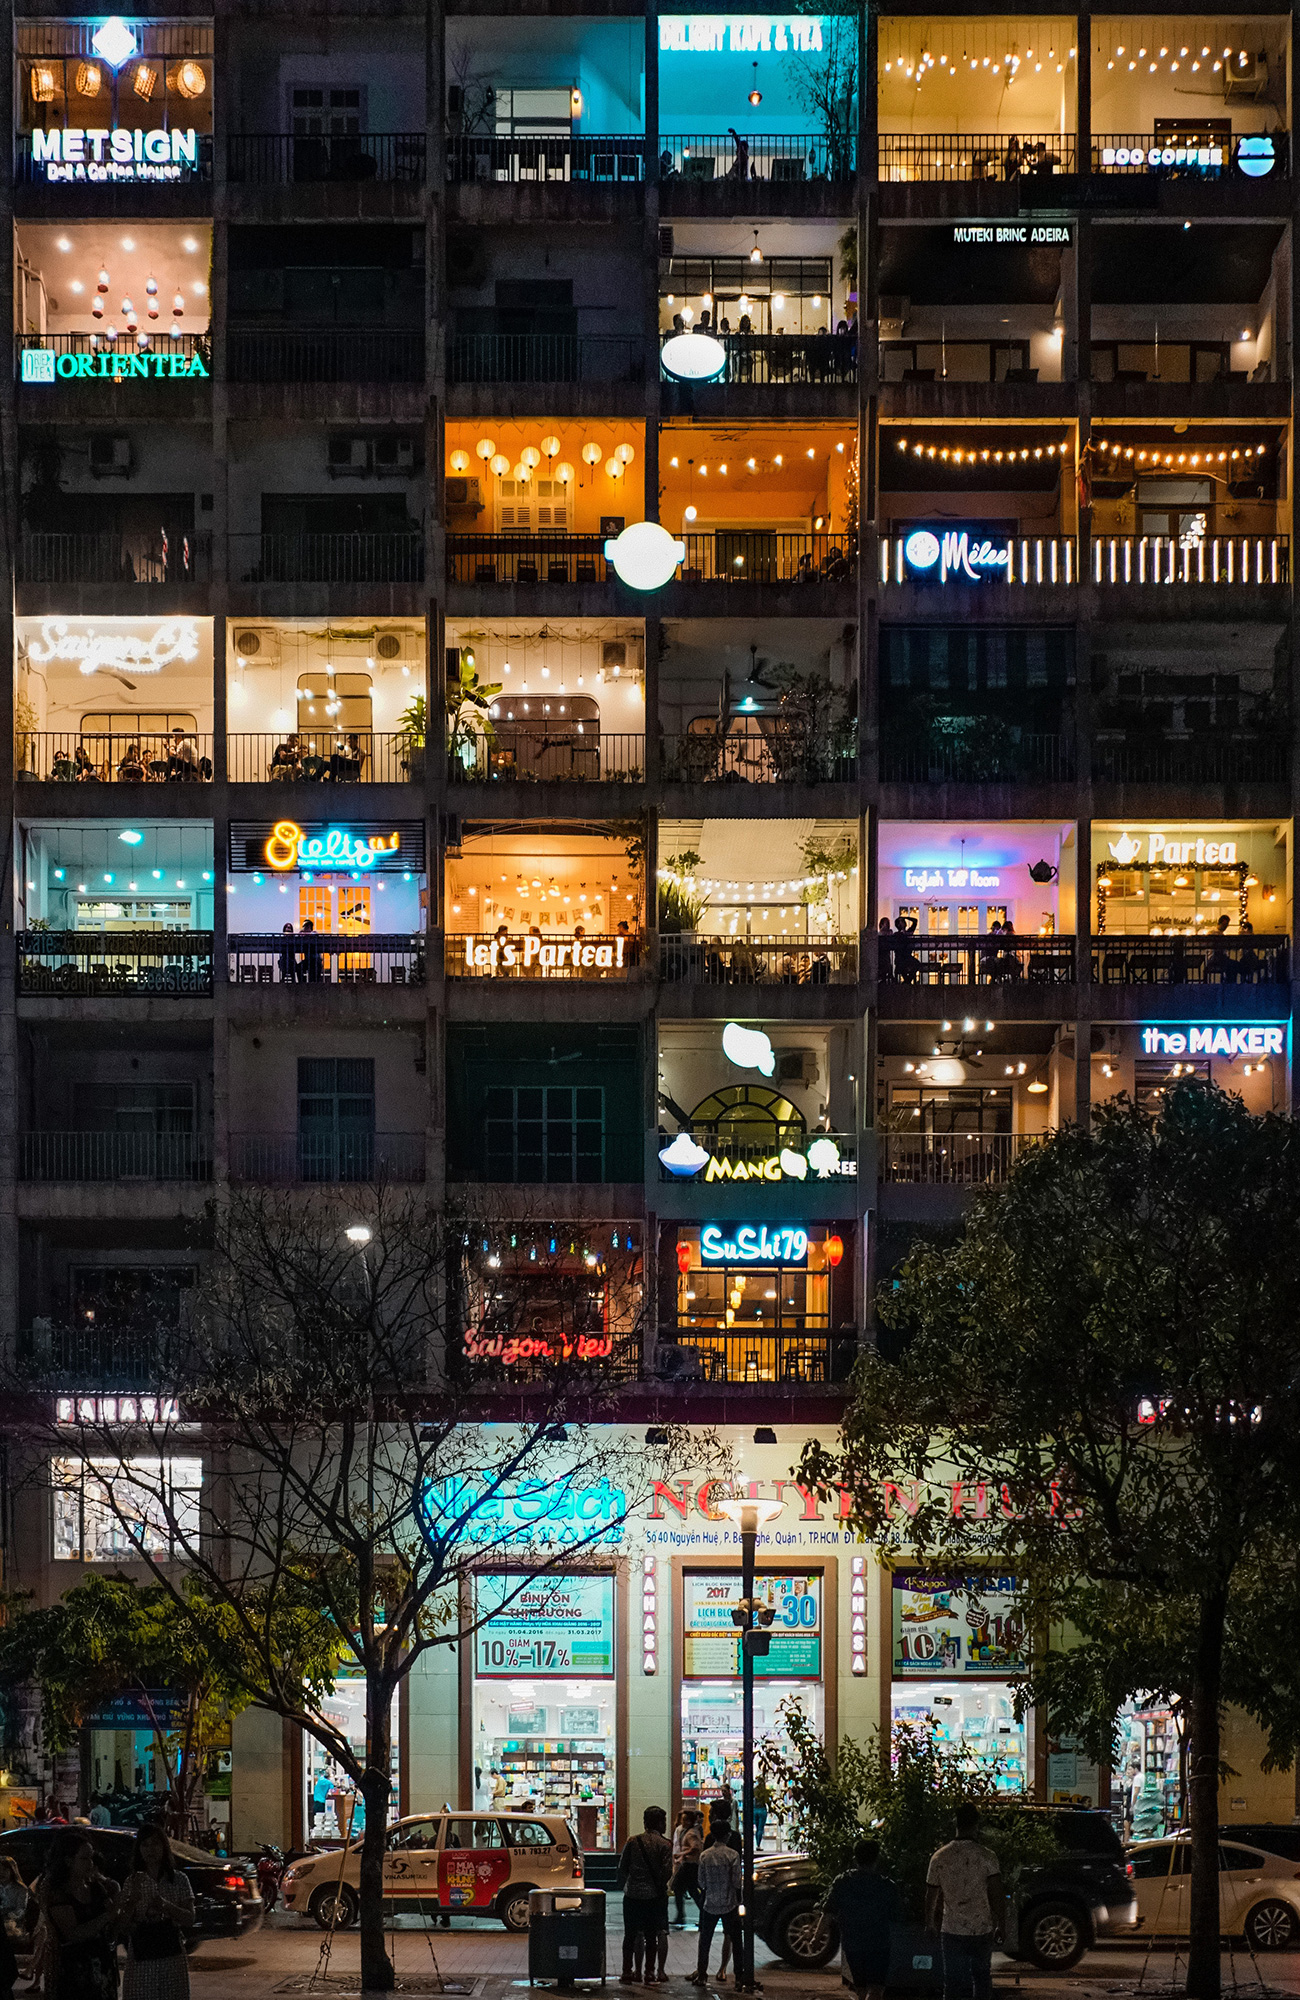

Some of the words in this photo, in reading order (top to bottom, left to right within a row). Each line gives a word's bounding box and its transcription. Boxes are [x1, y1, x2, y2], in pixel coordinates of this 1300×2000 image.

[775, 22, 787, 51] &
[790, 19, 824, 51] TEA
[32, 128, 196, 162] METSIGN
[1103, 148, 1144, 166] BOO
[1148, 148, 1222, 166] COFFEE
[954, 227, 993, 242] MUTEKI
[57, 353, 209, 378] ORIENTEA
[368, 832, 399, 850] CAÉ
[1148, 834, 1237, 864] Partea
[905, 869, 944, 893] English
[970, 869, 1000, 887] Room
[523, 936, 625, 968] Partea!
[1142, 1027, 1186, 1054] the
[1189, 1027, 1283, 1054] MAKER
[462, 1328, 553, 1365] Saigon
[422, 1470, 504, 1519] Nhà
[513, 1473, 626, 1520] Sách
[646, 1530, 657, 1544] Số
[658, 1531, 668, 1543] 40
[670, 1530, 700, 1546] Nguyễn
[775, 1531, 797, 1546] Quận
[809, 1531, 839, 1543] TP.HCM
[520, 1592, 548, 1603] BÌNH
[706, 1587, 731, 1598] 2017
[643, 1557, 656, 1671] FAHASA
[717, 1608, 735, 1617] BLO
[851, 1557, 865, 1672] FAHASA
[509, 1636, 530, 1647] GIẢM
